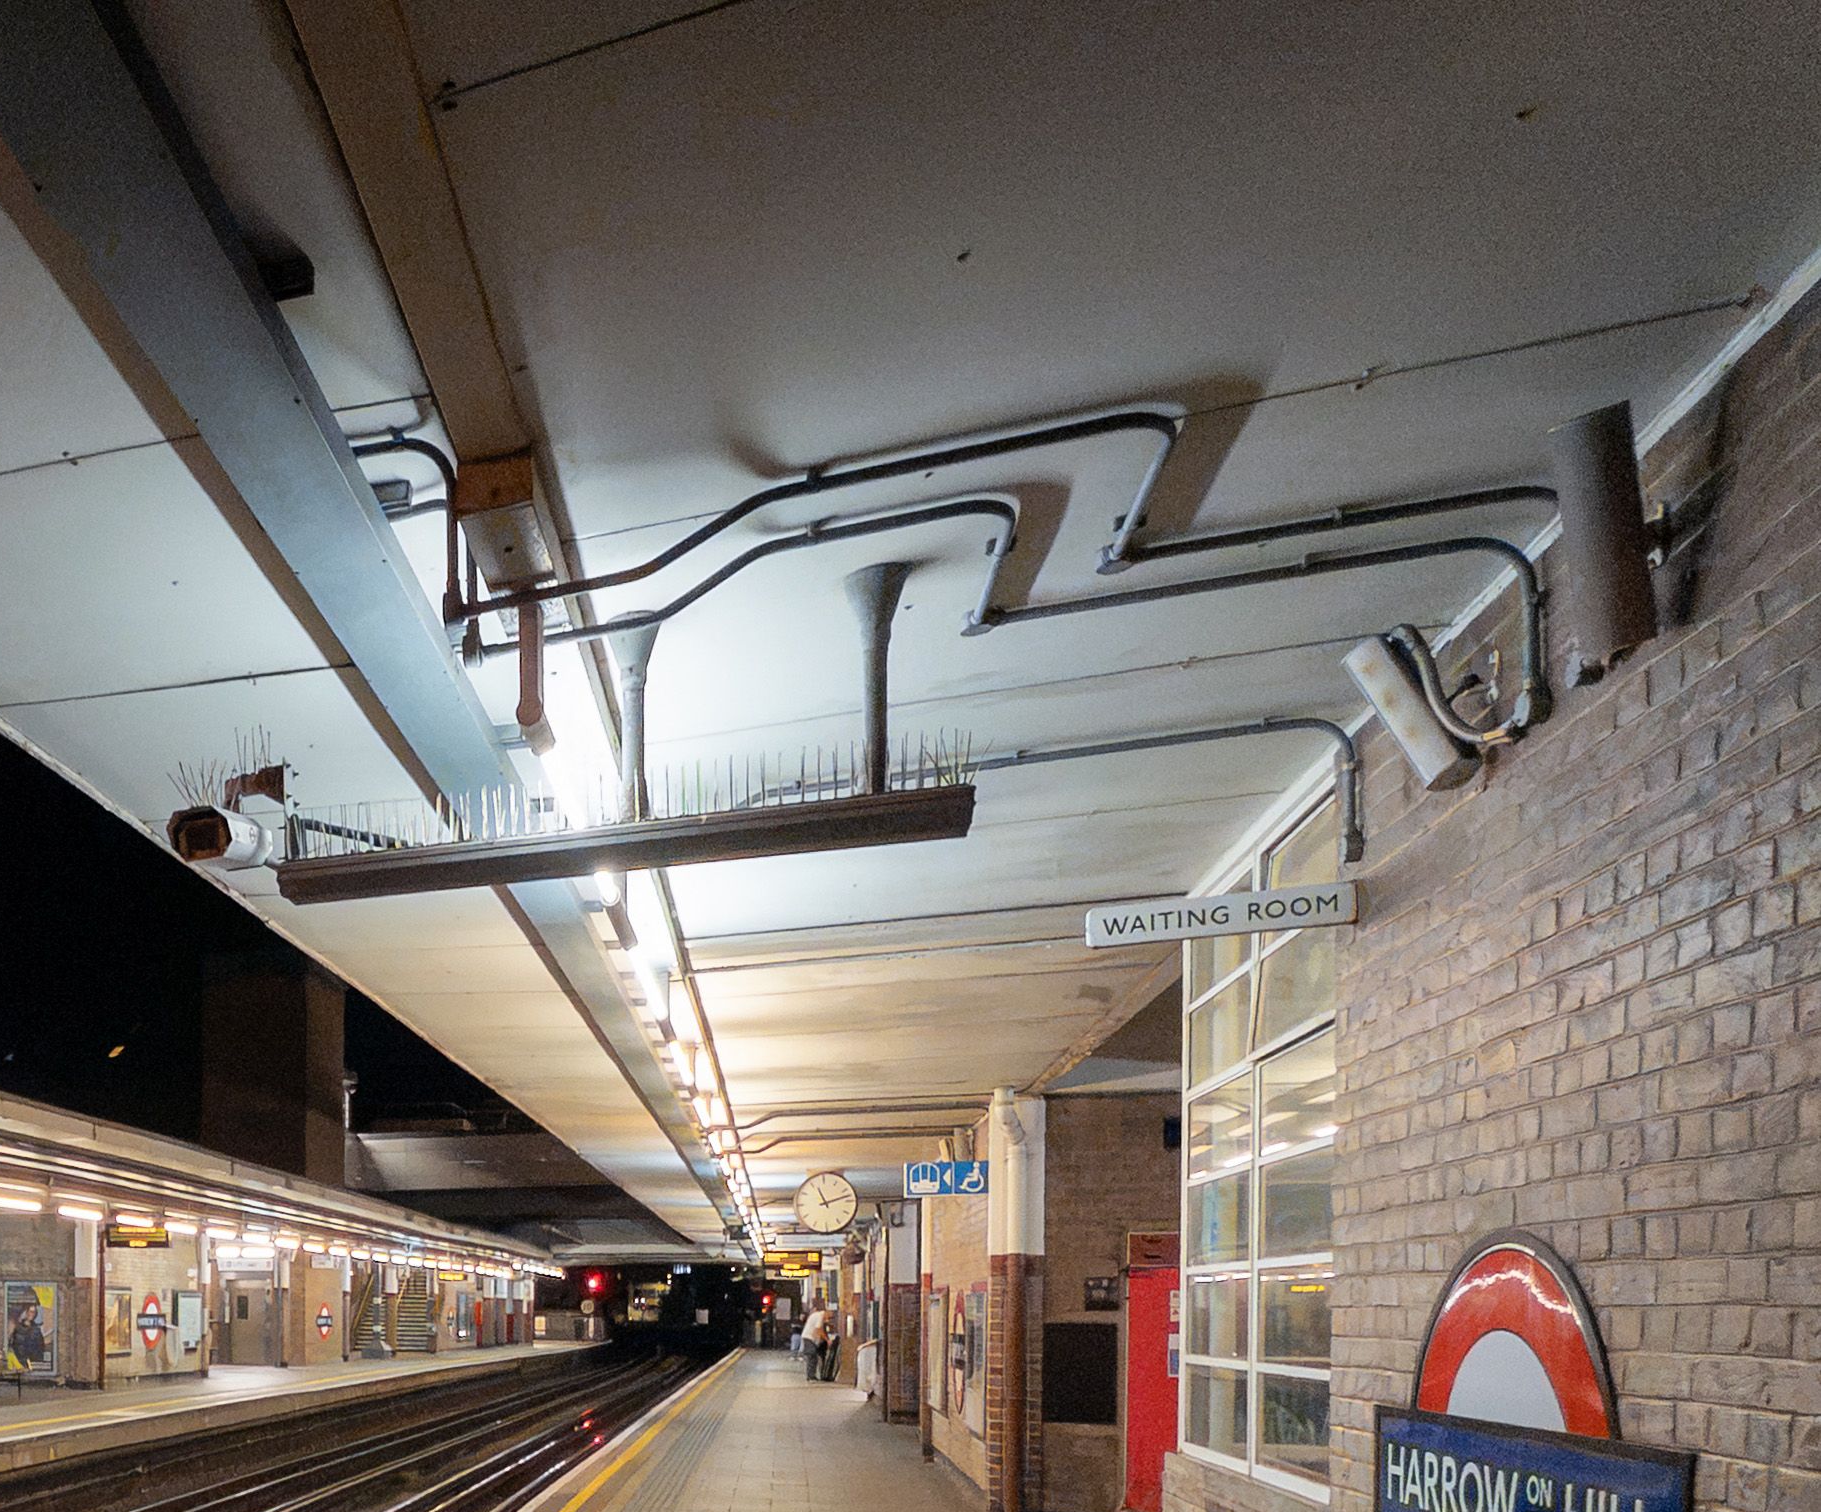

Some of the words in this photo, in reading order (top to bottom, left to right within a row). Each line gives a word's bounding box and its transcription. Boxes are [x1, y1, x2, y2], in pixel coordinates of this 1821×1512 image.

[1102, 905, 1230, 936] WAITING
[1247, 893, 1339, 921] ROOM
[1526, 1474, 1552, 1508] ON
